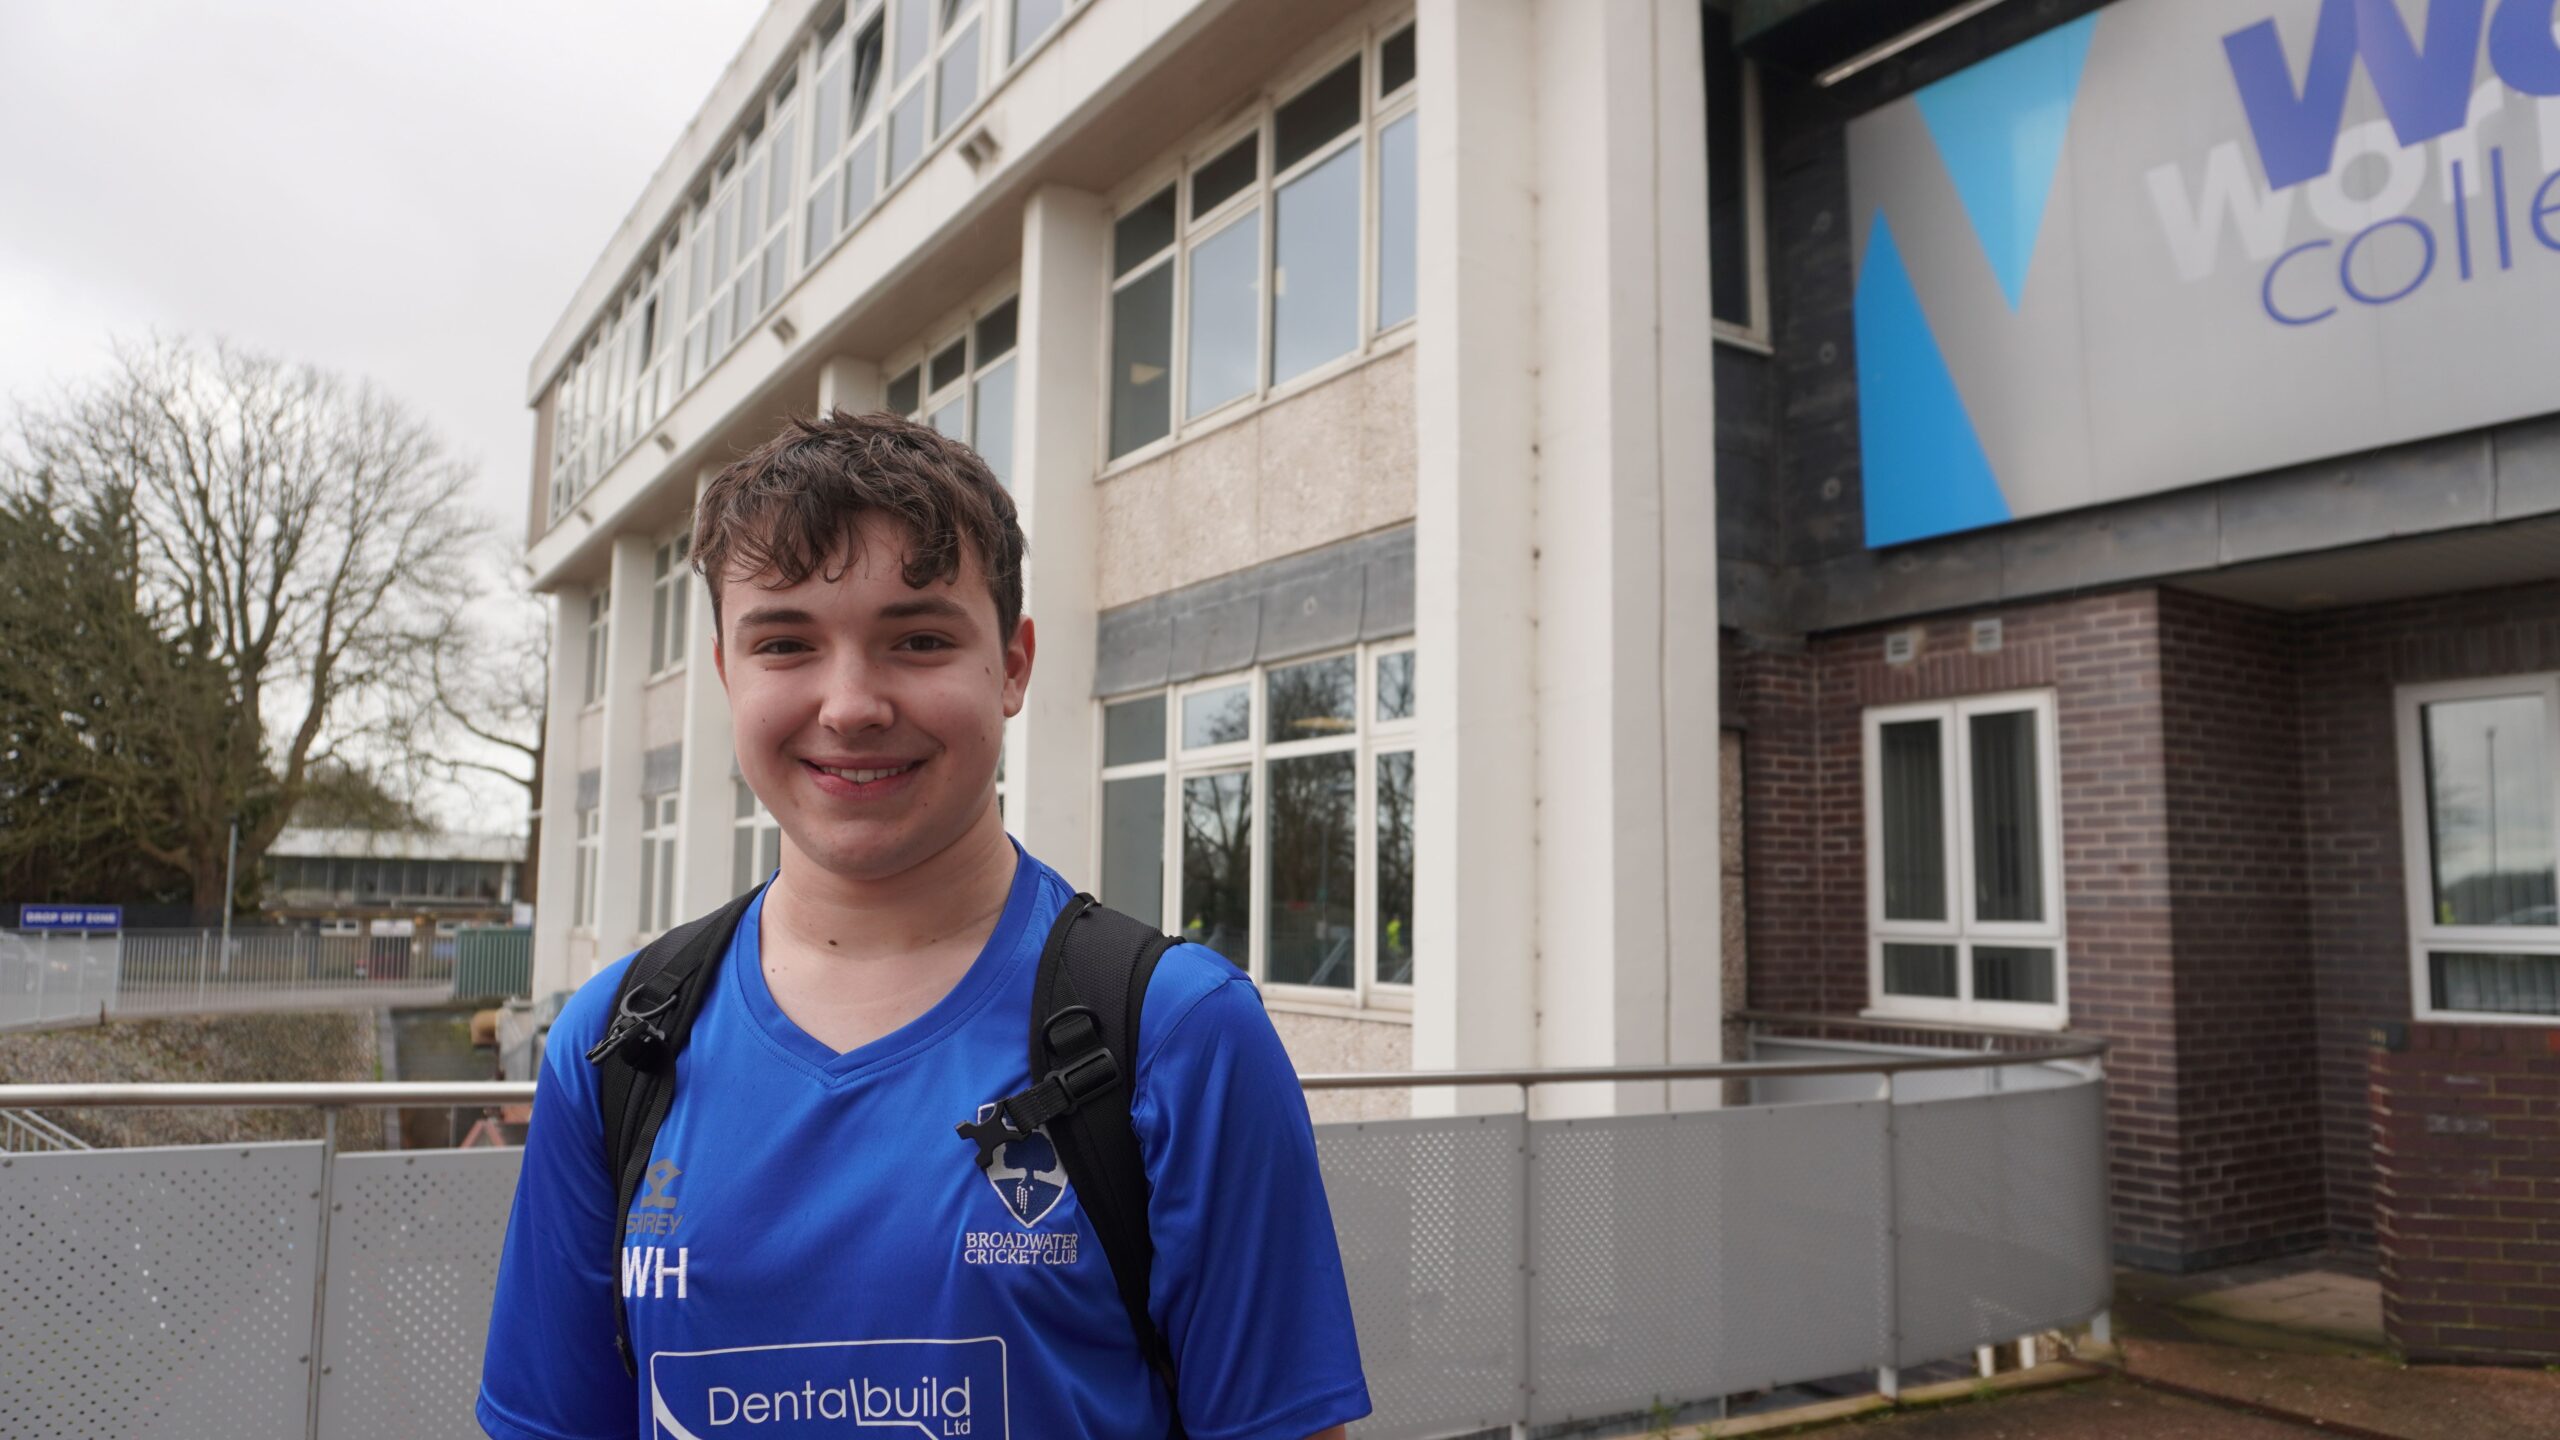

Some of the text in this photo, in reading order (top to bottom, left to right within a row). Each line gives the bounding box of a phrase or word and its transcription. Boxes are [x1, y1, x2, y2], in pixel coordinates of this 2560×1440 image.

[2145, 77, 2560, 284] wor
[26, 911, 117, 925] DROP OFF ZONE
[965, 1231, 1078, 1250] BROADWATER
[963, 1248, 1078, 1266] CRICKET CLUB
[621, 1245, 689, 1300] WH
[707, 1375, 971, 1426] Dentalbuild
[943, 1418, 971, 1436] Ltd
